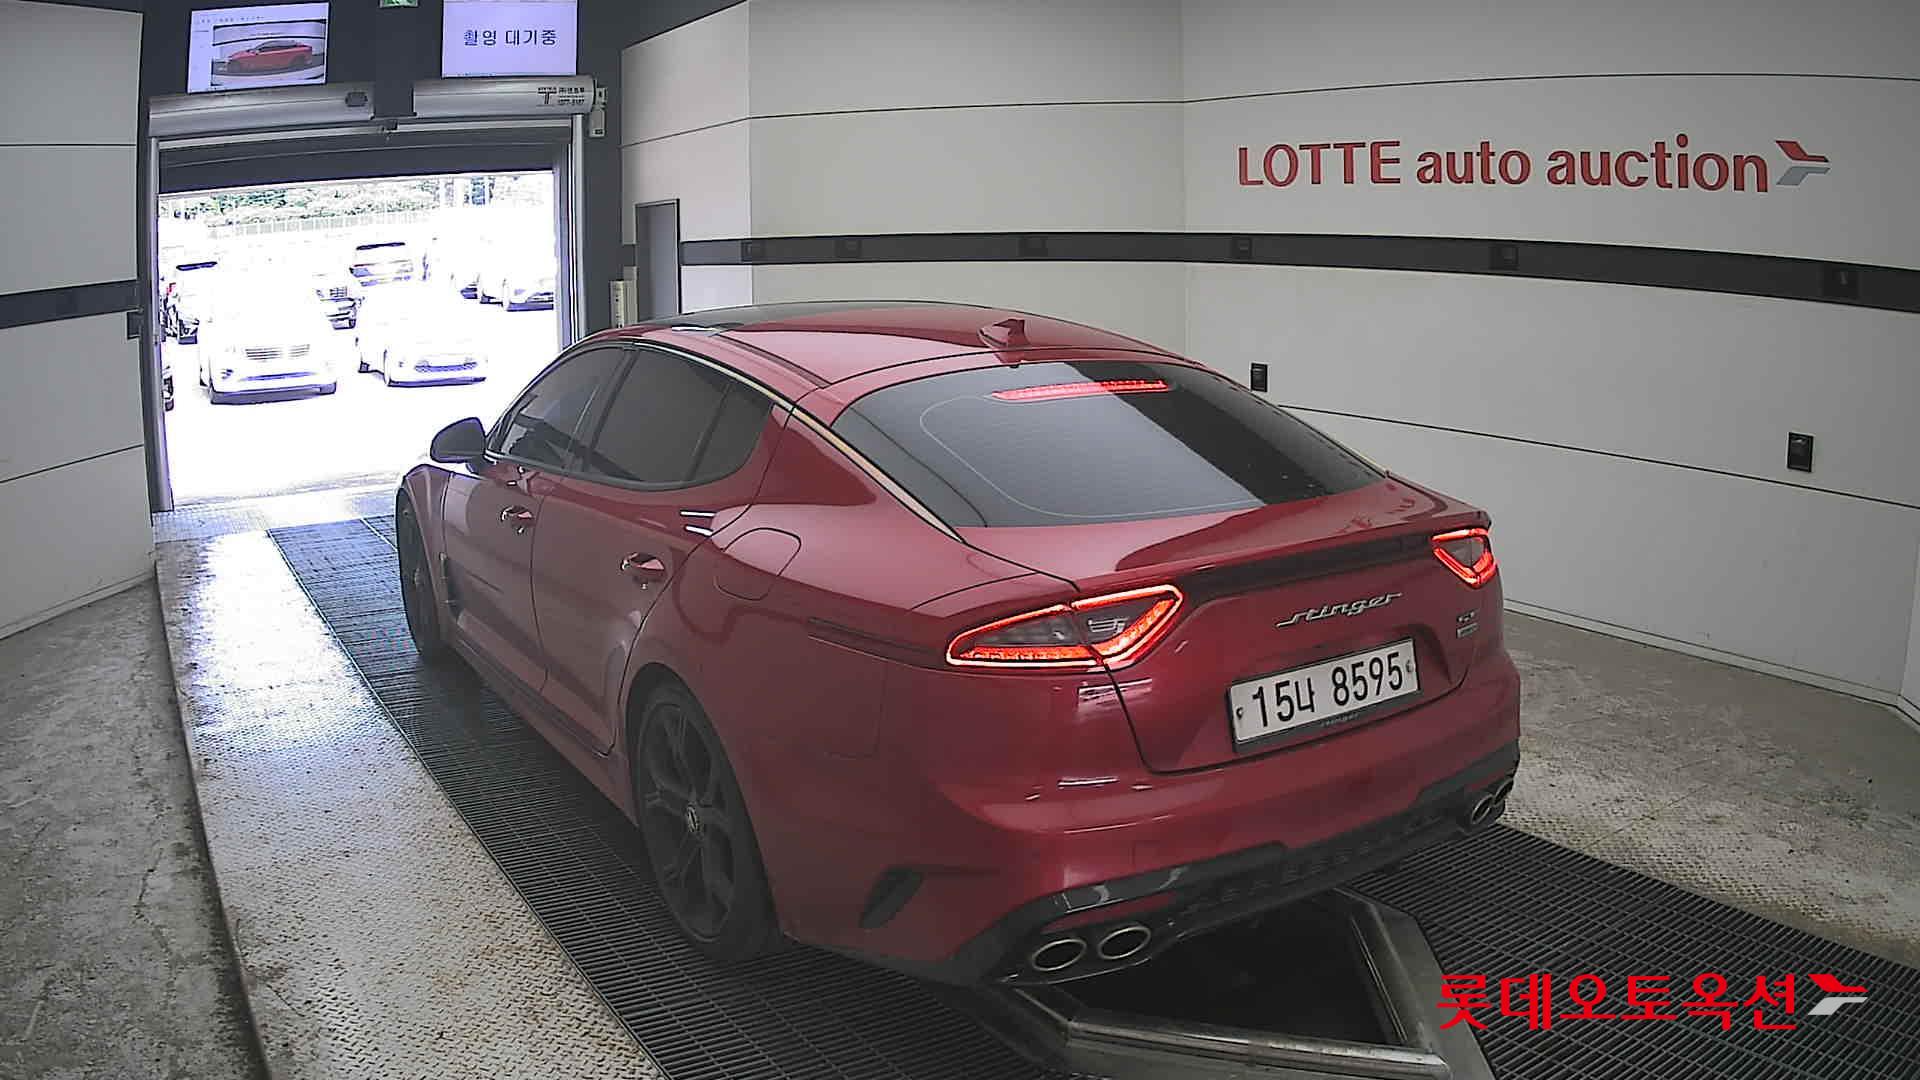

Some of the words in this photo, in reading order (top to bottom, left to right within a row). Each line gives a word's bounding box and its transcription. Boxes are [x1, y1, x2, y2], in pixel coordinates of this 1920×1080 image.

[505, 29, 557, 46] 대기중
[1237, 140, 1401, 187] LOTTE
[1416, 141, 1531, 185] auto
[1546, 133, 1768, 192] auction
[1251, 676, 1316, 728] 15나
[1331, 651, 1404, 707] 8595
